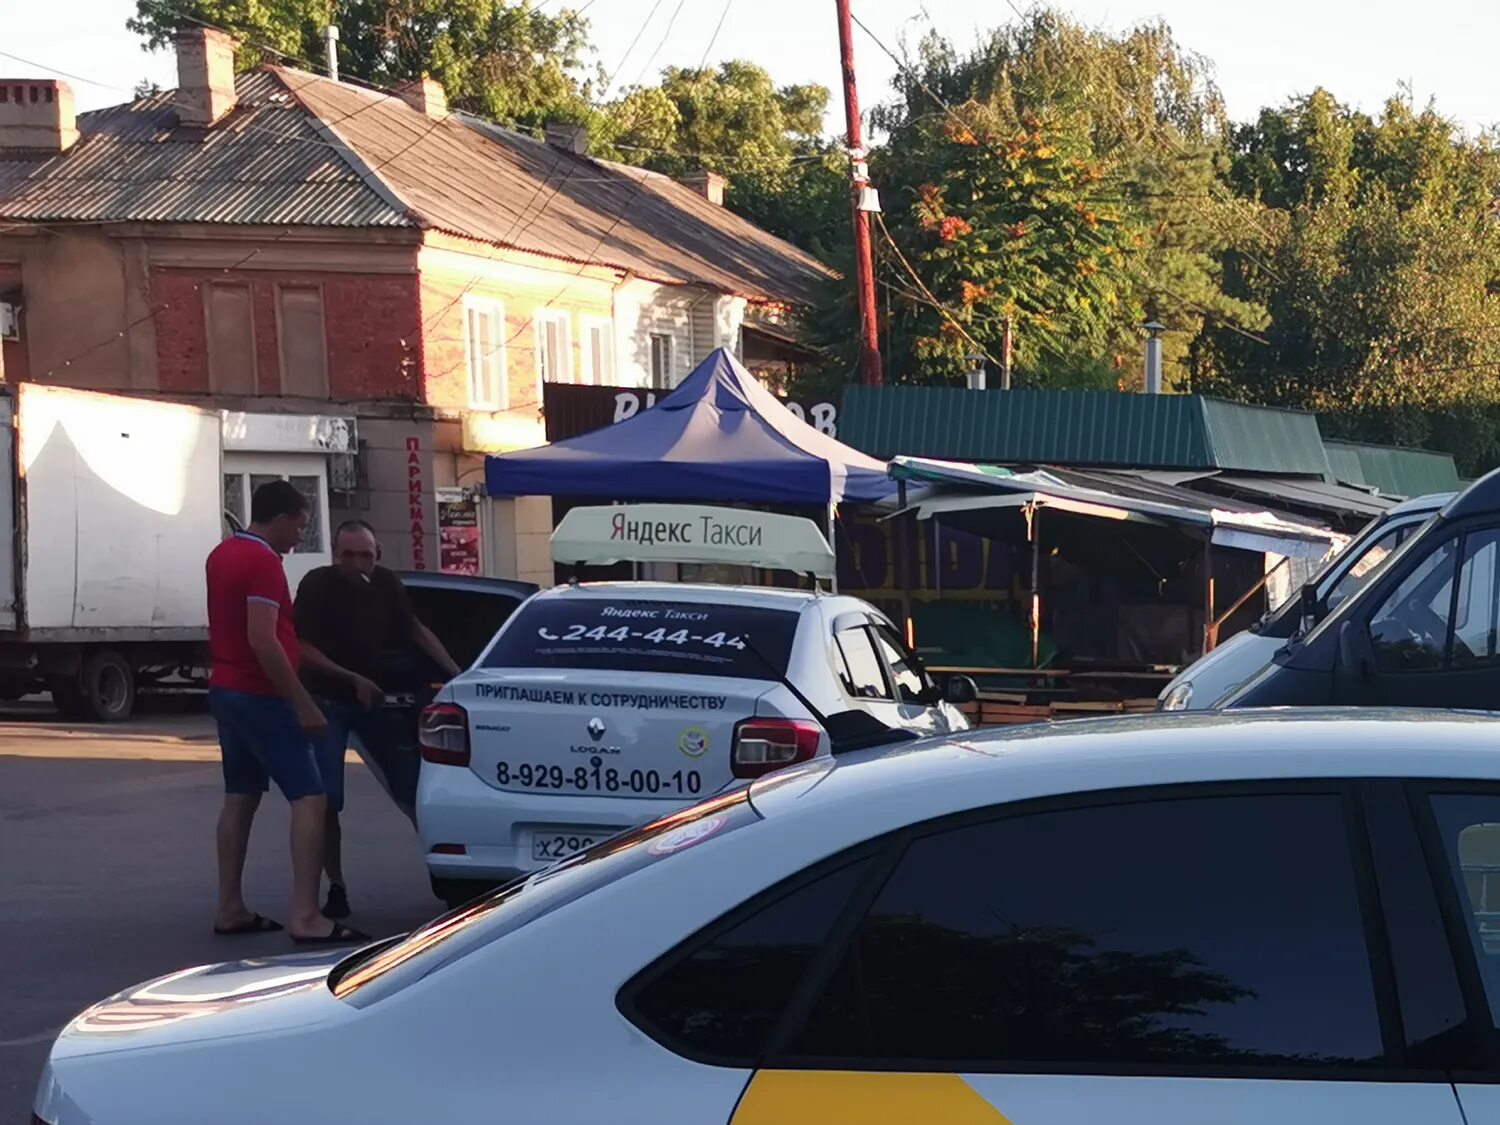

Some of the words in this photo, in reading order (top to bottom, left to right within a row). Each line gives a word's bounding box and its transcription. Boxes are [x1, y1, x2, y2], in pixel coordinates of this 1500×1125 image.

[610, 513, 692, 544] Яндекс
[699, 516, 763, 546] Такси
[601, 606, 659, 620] Яндекс
[664, 608, 709, 621] Такси
[562, 624, 747, 650] 244-44-44
[475, 683, 574, 706] ПРИГЛАШАЕМ
[578, 693, 588, 706] К
[591, 693, 727, 710] СОТРУДНИЧЕСТВУ
[570, 745, 621, 756] LOGAN
[496, 761, 702, 794] 8-929-818-00-10
